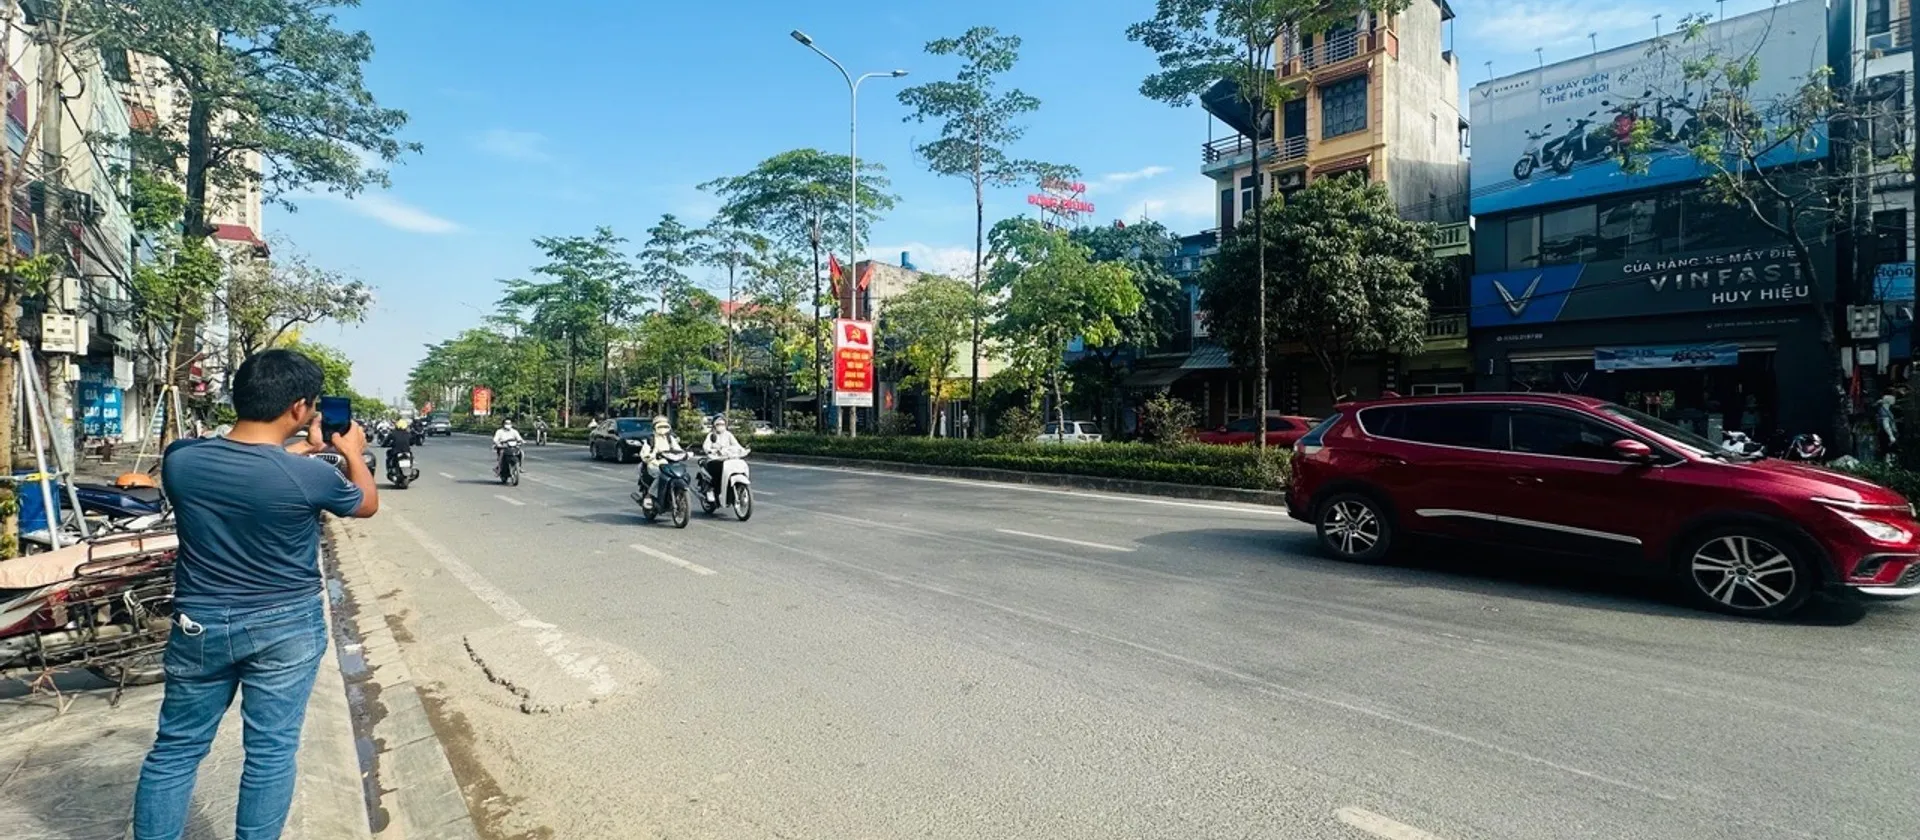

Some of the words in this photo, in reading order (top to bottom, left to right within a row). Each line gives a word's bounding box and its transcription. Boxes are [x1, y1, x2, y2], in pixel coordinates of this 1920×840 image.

[1623, 259, 1651, 273] CỬA
[1729, 249, 1764, 263] MÁY
[1769, 245, 1798, 259] ĐIỆ
[1650, 262, 1802, 292] VINFAST
[1712, 290, 1752, 304] HUY
[1760, 283, 1809, 301] HIỆU
